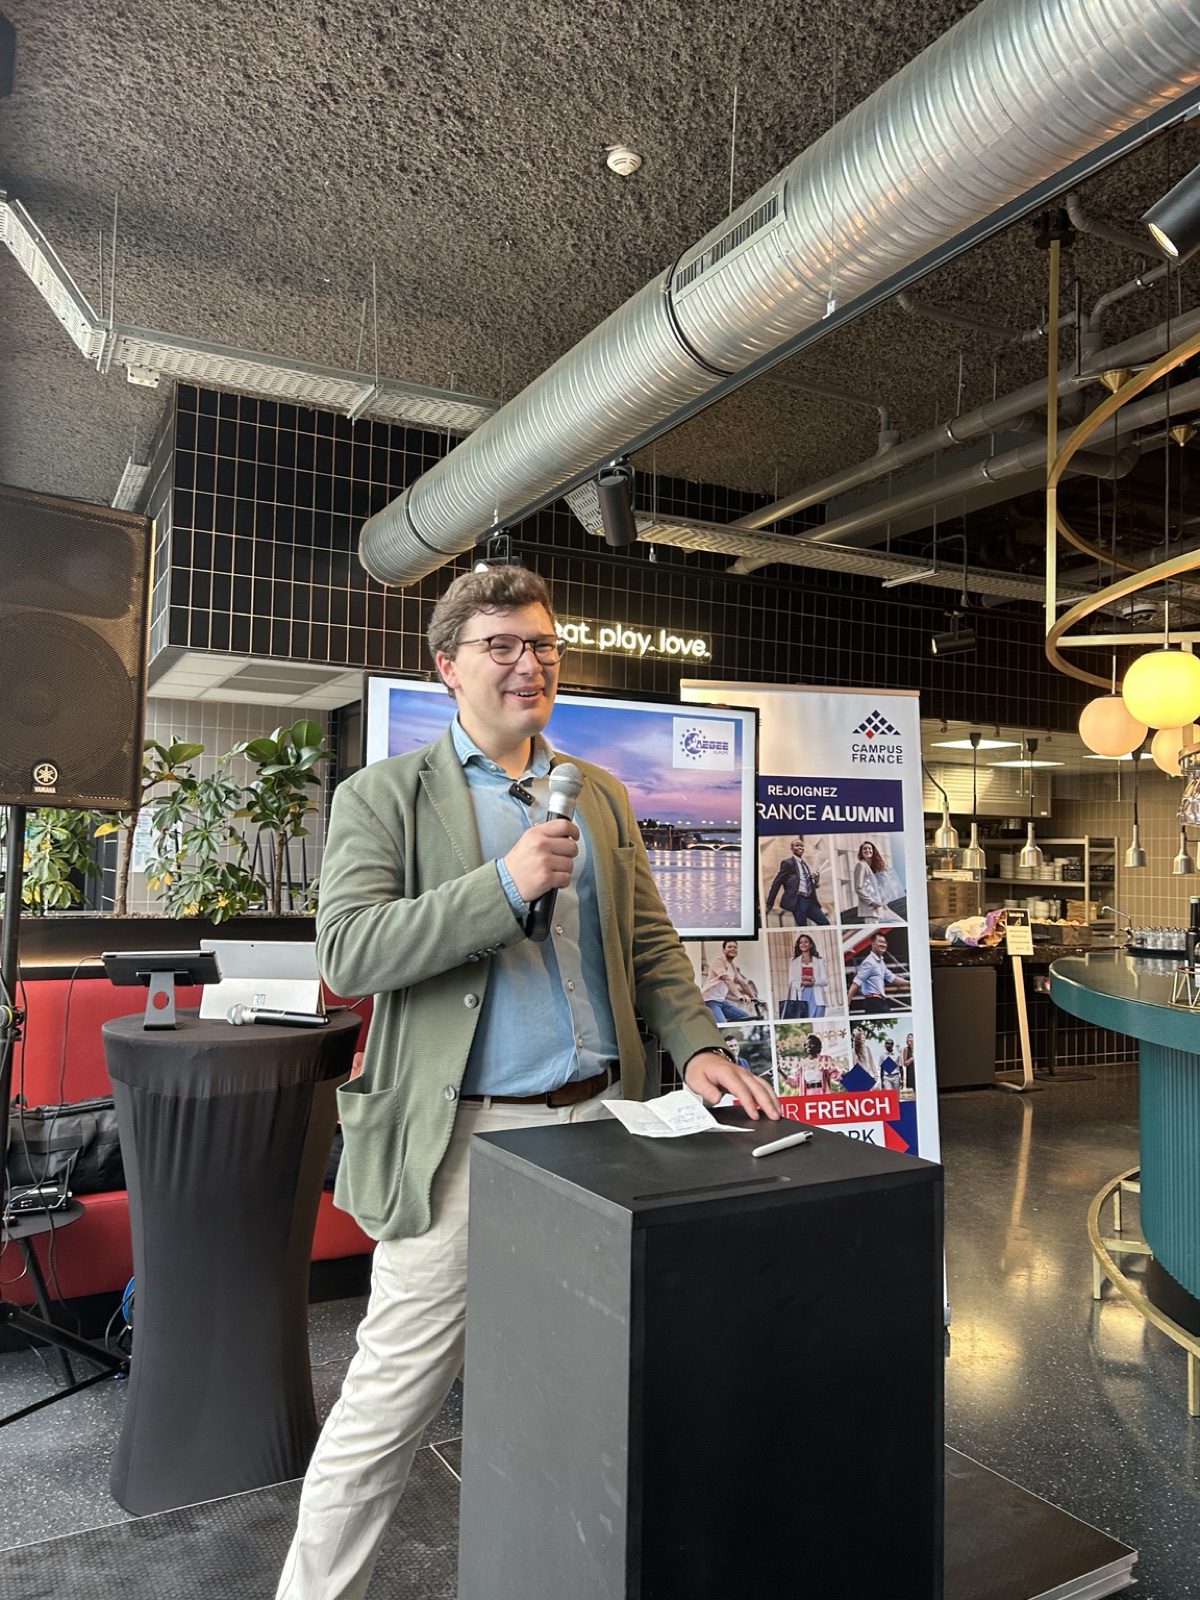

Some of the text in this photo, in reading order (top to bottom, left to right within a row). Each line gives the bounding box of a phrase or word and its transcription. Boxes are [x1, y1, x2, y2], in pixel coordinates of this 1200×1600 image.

[600, 623, 655, 655] play.
[660, 629, 711, 657] love.
[696, 740, 729, 750] AEGEE
[852, 743, 903, 754] CAMPUS
[852, 753, 903, 764] FRANCE
[767, 784, 838, 798] REJOIGNEZ
[757, 803, 895, 823] RANCE ALUMNI
[804, 1097, 891, 1121] FRENCH
